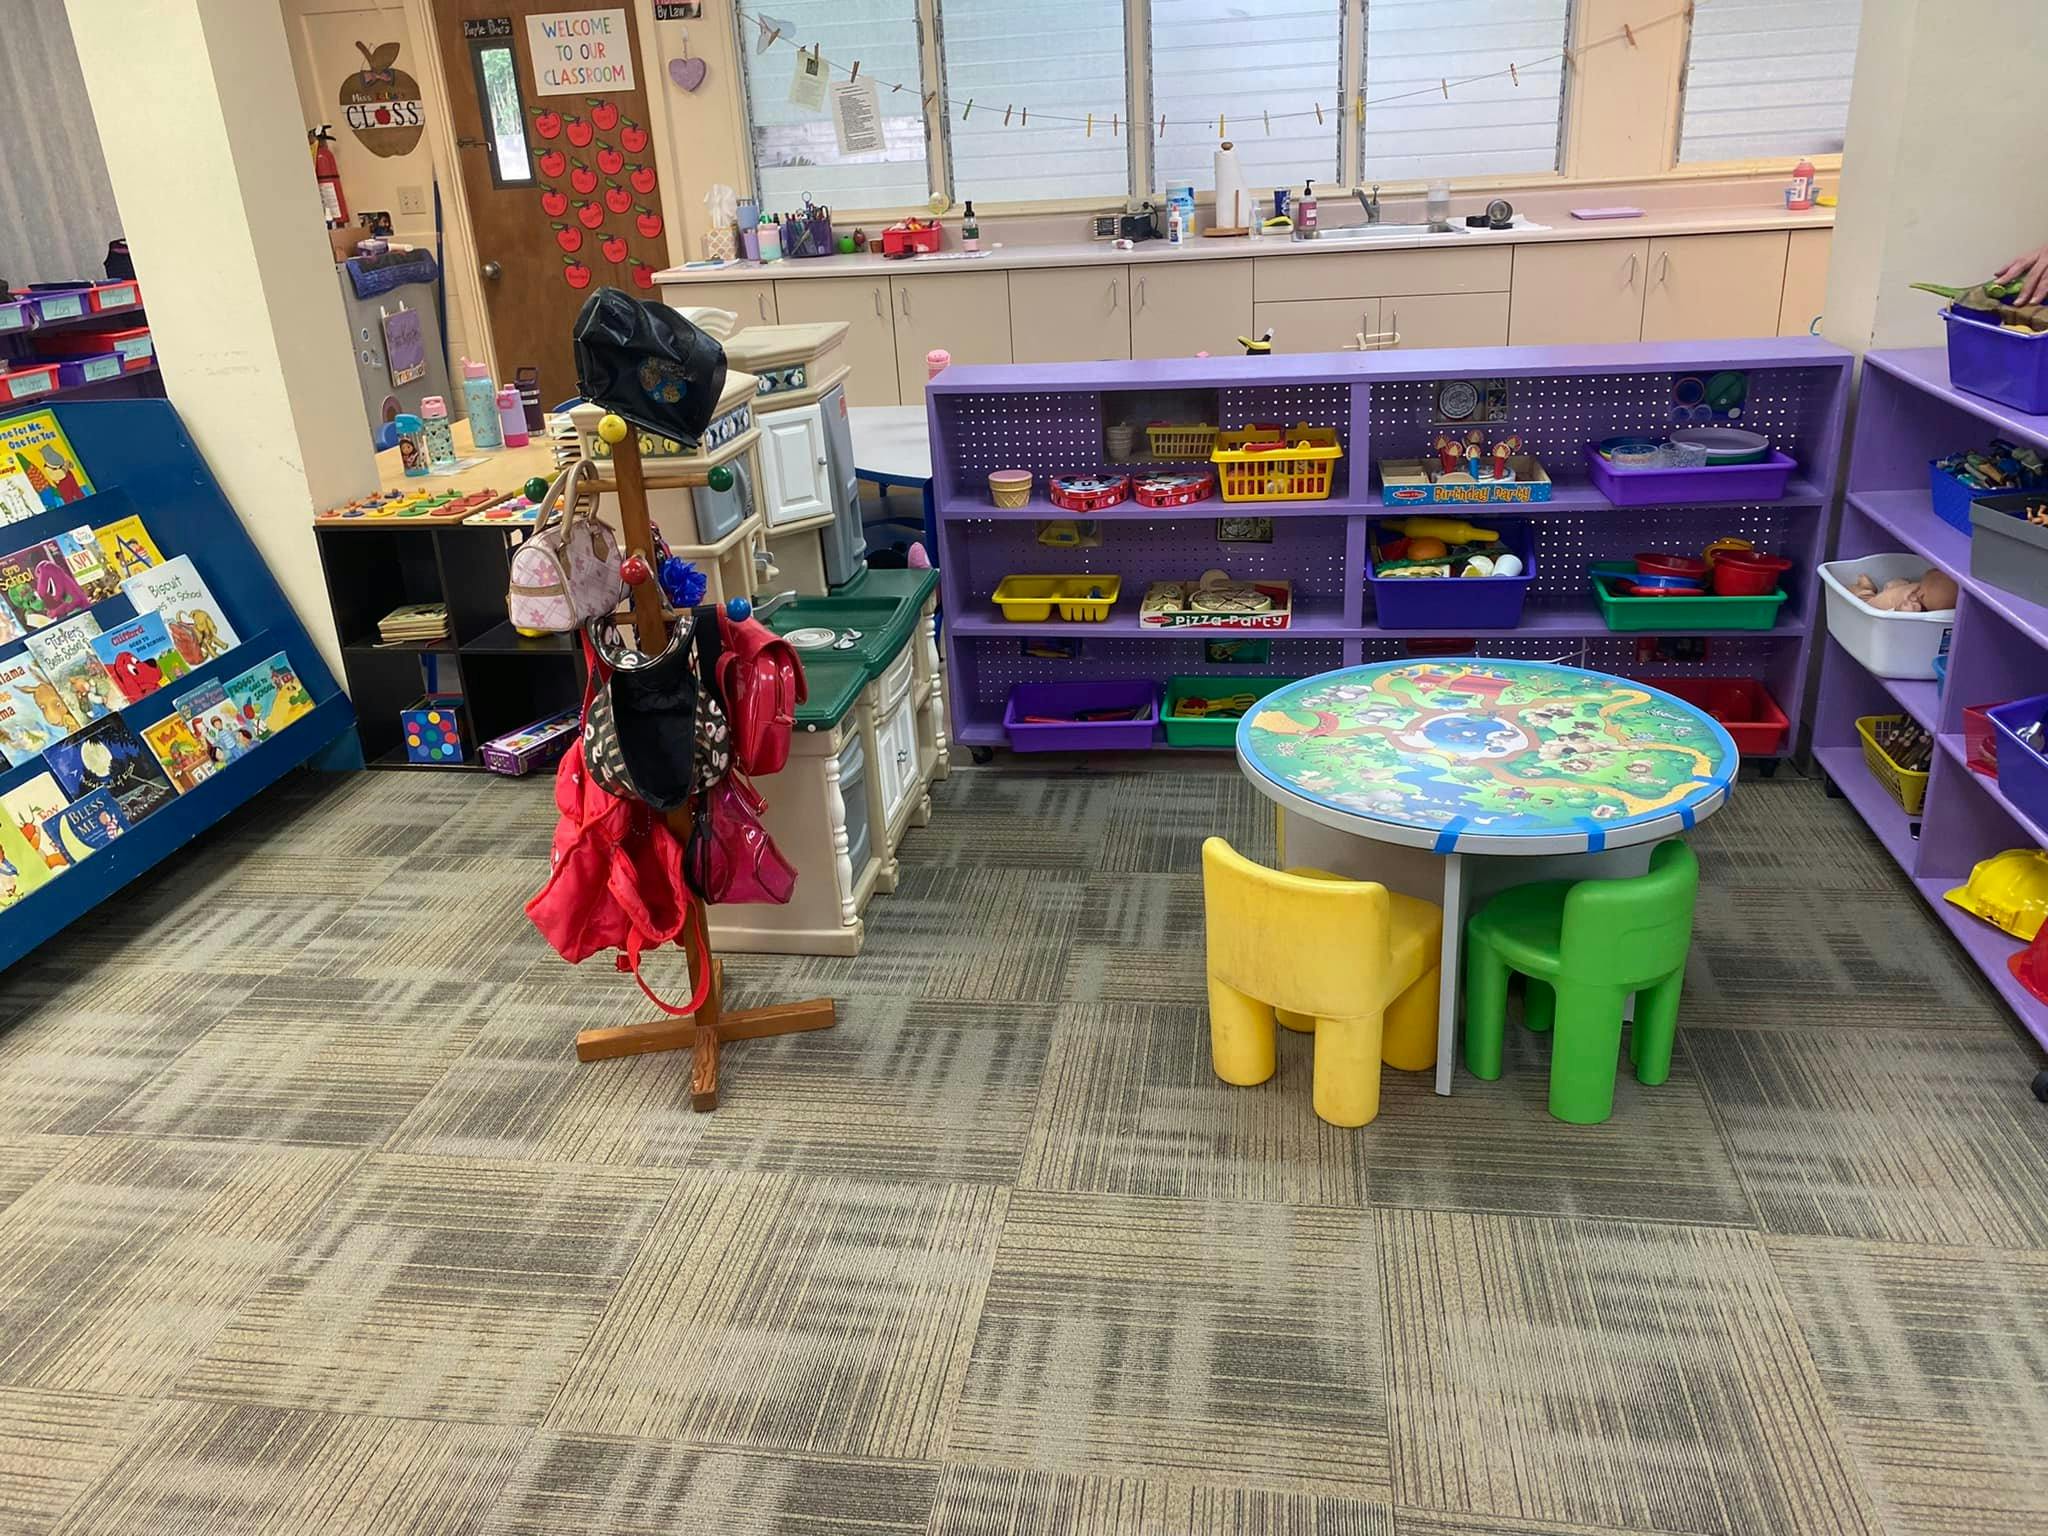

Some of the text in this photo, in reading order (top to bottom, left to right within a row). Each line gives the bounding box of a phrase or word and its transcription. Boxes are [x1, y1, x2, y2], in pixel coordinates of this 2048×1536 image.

[541, 17, 612, 38] WELCOME
[555, 42, 606, 60] TO OUR
[544, 65, 626, 86] CLASSROOM
[347, 101, 419, 129] CLSS
[8, 439, 26, 450] One
[41, 431, 56, 441] You
[1152, 495, 1177, 505] LVE
[1434, 486, 1490, 503] Birthday
[1494, 485, 1531, 503] Party
[73, 550, 93, 570] SPY
[0, 568, 34, 591] School
[148, 575, 183, 599] Biscuit
[167, 595, 176, 604] to
[177, 588, 202, 601] School
[44, 626, 85, 650] Tucker's
[111, 625, 144, 646] Clifford
[0, 666, 26, 685] lama
[68, 797, 105, 825] BLESS
[77, 818, 98, 837] ME
